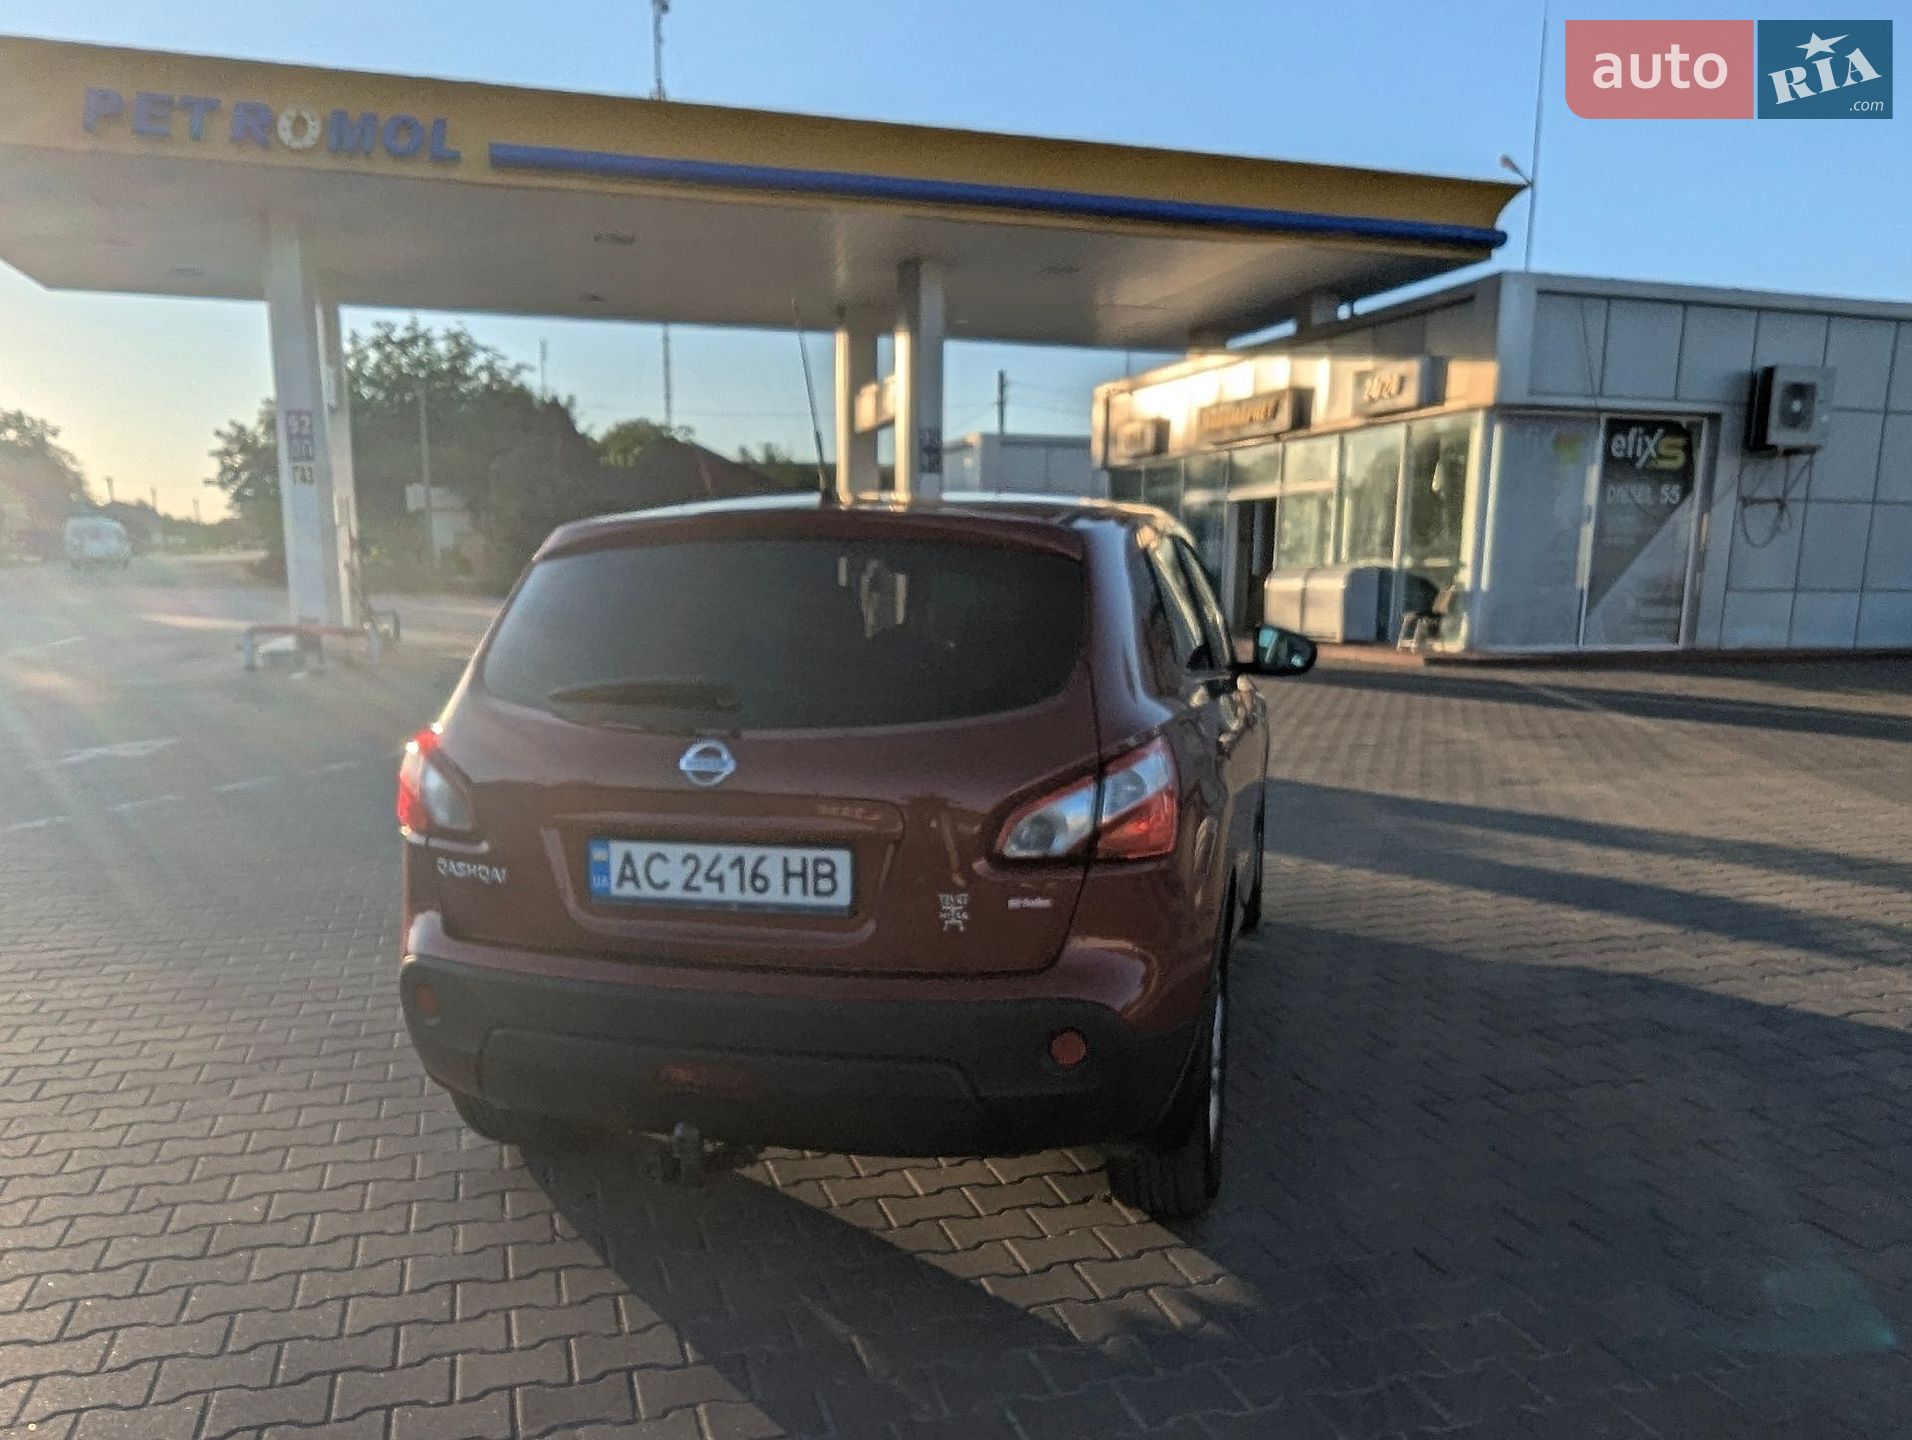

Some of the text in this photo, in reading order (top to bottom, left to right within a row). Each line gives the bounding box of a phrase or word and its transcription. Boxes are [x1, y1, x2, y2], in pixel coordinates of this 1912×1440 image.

[82, 87, 462, 162] PETROMOL
[616, 850, 839, 898] AC 2416 HB
